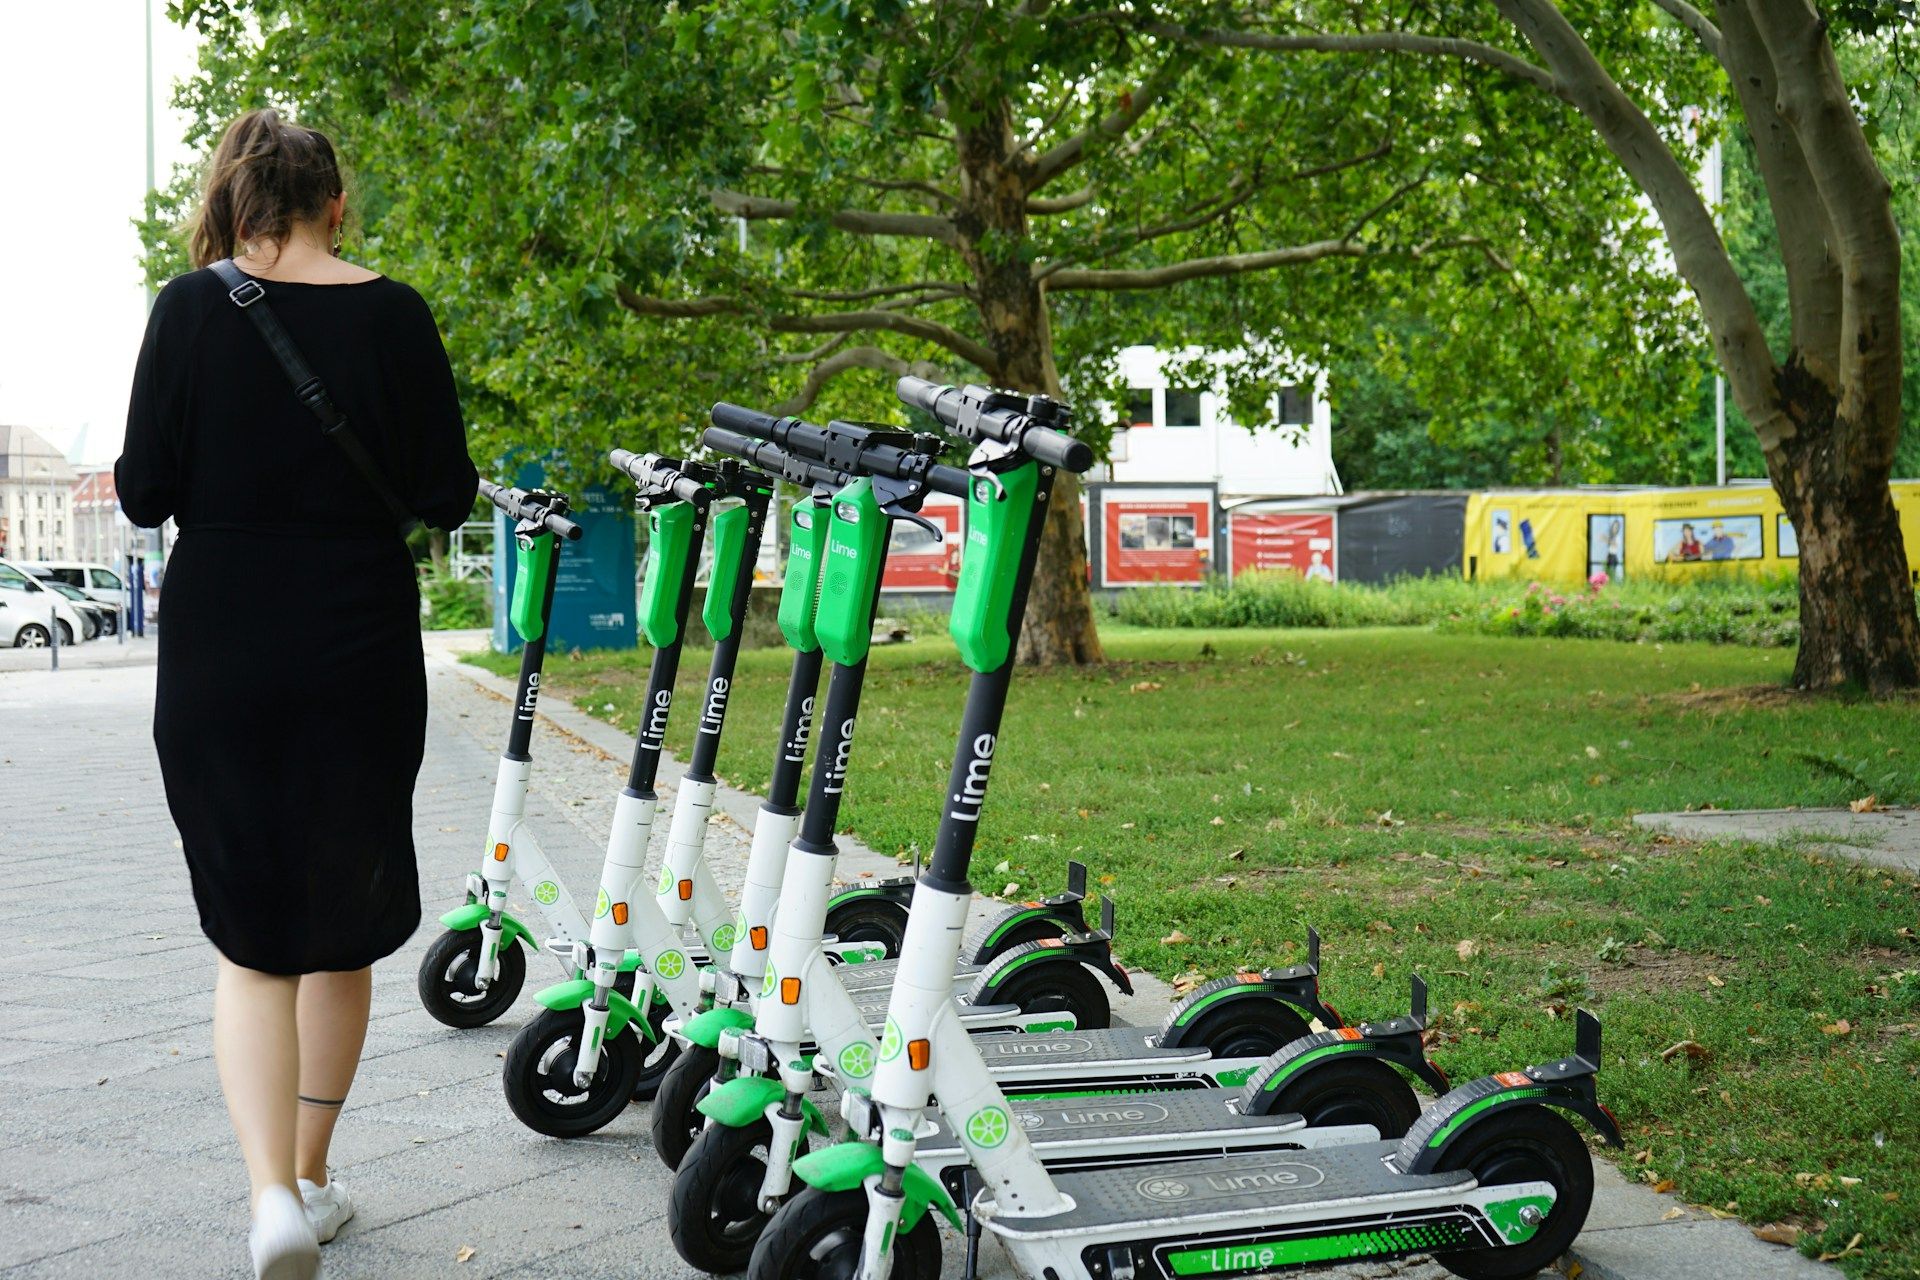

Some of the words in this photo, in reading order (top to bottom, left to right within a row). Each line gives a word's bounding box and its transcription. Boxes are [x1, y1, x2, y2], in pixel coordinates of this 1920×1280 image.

[969, 525, 988, 546] Lime
[790, 542, 811, 560] Lime
[831, 539, 857, 559] Lime
[518, 672, 541, 720] Lime
[700, 677, 728, 735] Lime
[641, 689, 671, 750] Lime
[785, 696, 815, 762] Lime
[824, 718, 855, 794] Lime
[951, 733, 996, 822] Lime
[998, 1042, 1072, 1054] Lime
[1061, 1109, 1145, 1124] Lime
[1207, 1170, 1299, 1192] Lime
[1211, 1247, 1275, 1271] Lime
